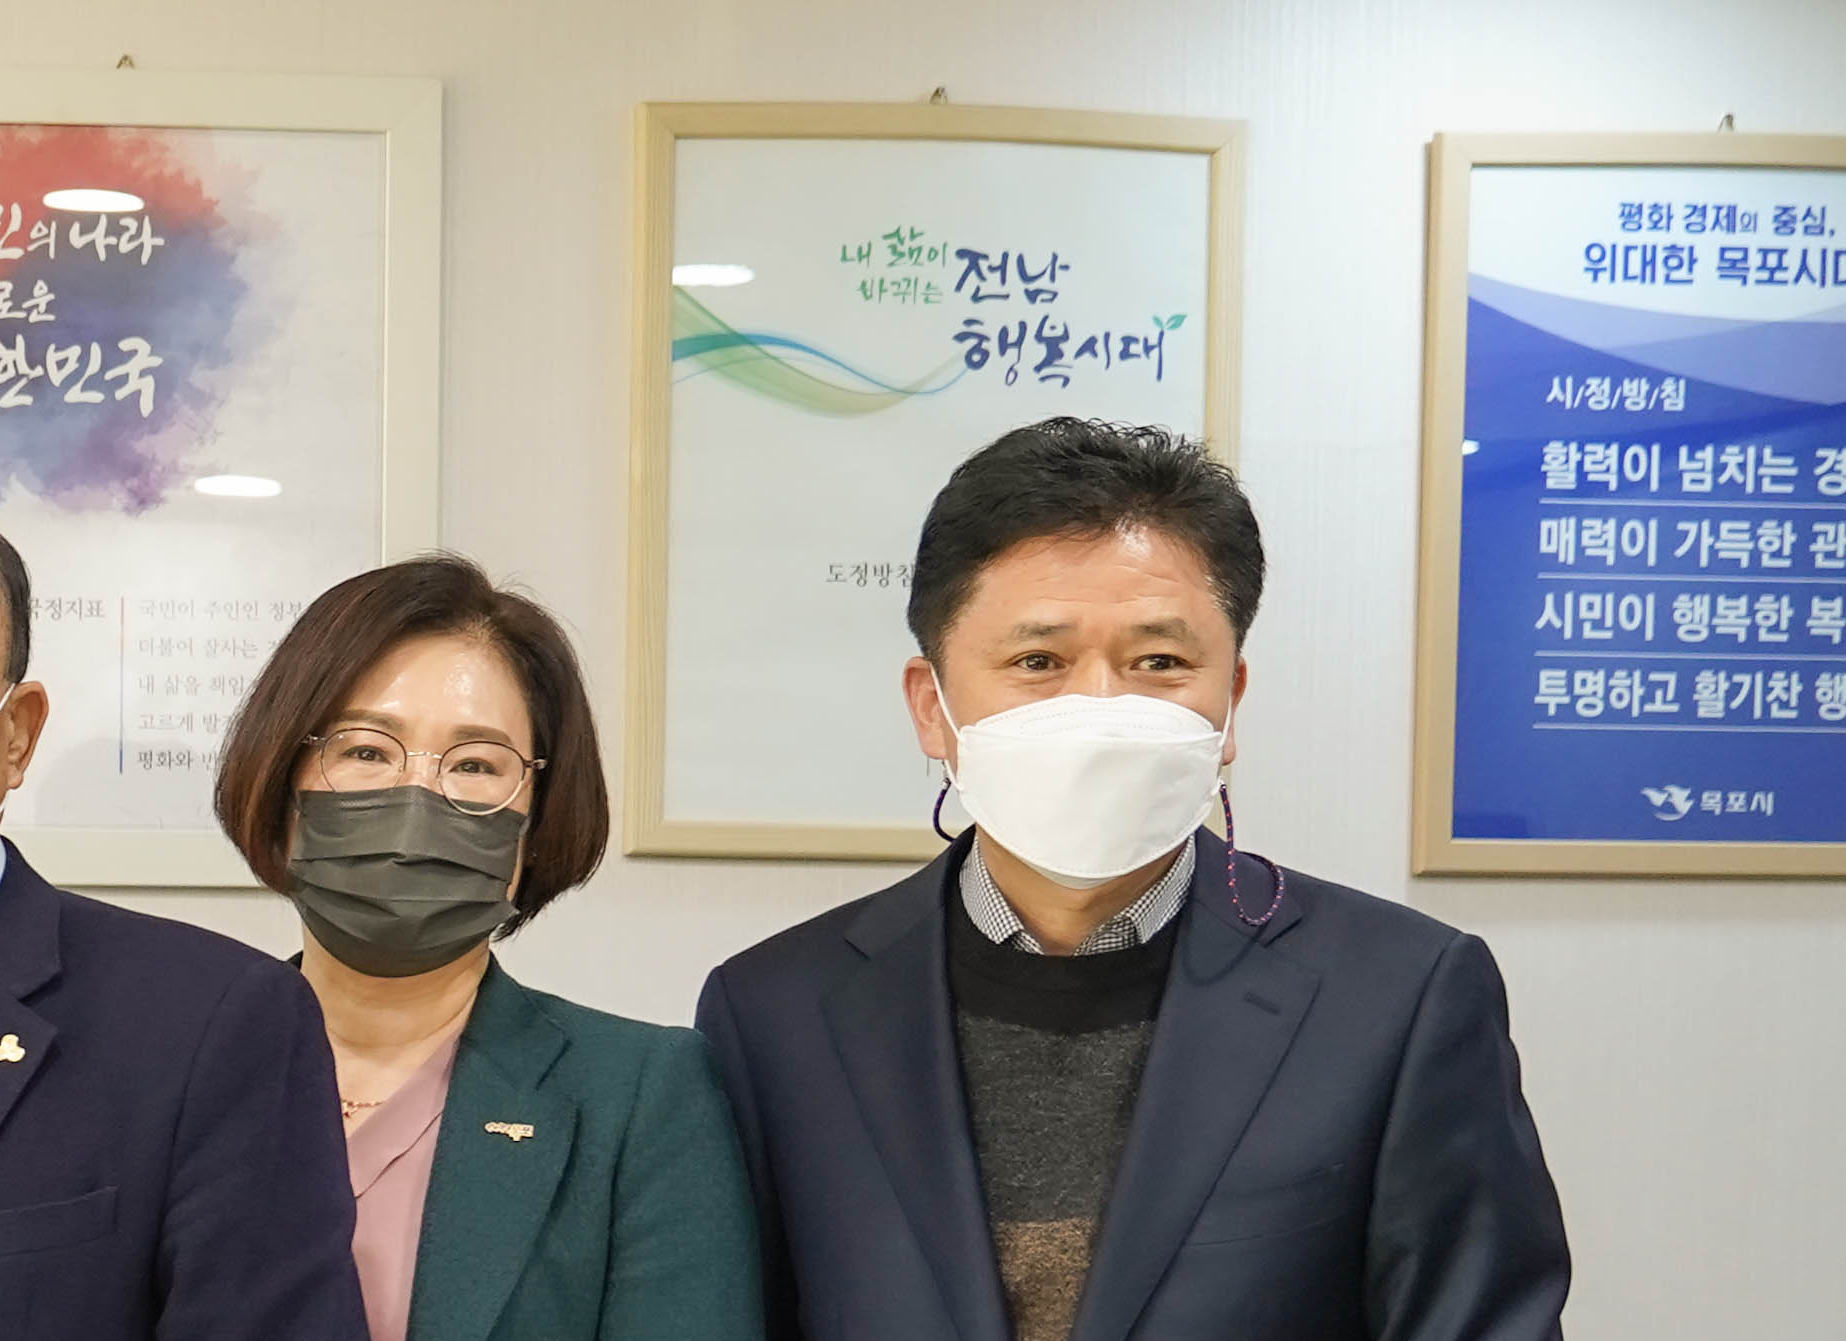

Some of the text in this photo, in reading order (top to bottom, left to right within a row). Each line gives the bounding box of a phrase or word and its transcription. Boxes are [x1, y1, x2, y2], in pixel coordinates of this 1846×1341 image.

[69, 214, 165, 265] 나라
[1619, 203, 1835, 237] 평화 경제의 중심,
[841, 225, 947, 268] 내 삶이
[1584, 242, 1699, 285] 위대한
[954, 249, 1070, 304] 전남
[952, 315, 1166, 389] 행복시대
[1541, 440, 1659, 492] 활력이
[1678, 443, 1798, 494] 넘치는
[1539, 516, 1657, 567] 매력이
[1674, 519, 1797, 568] 가득한
[138, 600, 195, 620] 국민이
[203, 600, 260, 620] 주인인
[1534, 591, 1846, 644] 시민이 행복한 복
[138, 638, 194, 657] 더불어
[203, 638, 259, 657] 잘사는
[138, 675, 250, 697] 내 삶을 책임
[1534, 668, 1681, 718] 투명하고
[1693, 670, 1804, 720] 활기찬
[138, 713, 195, 733] 고르게
[137, 751, 194, 771] 평화와
[1699, 790, 1775, 817] 목포시
